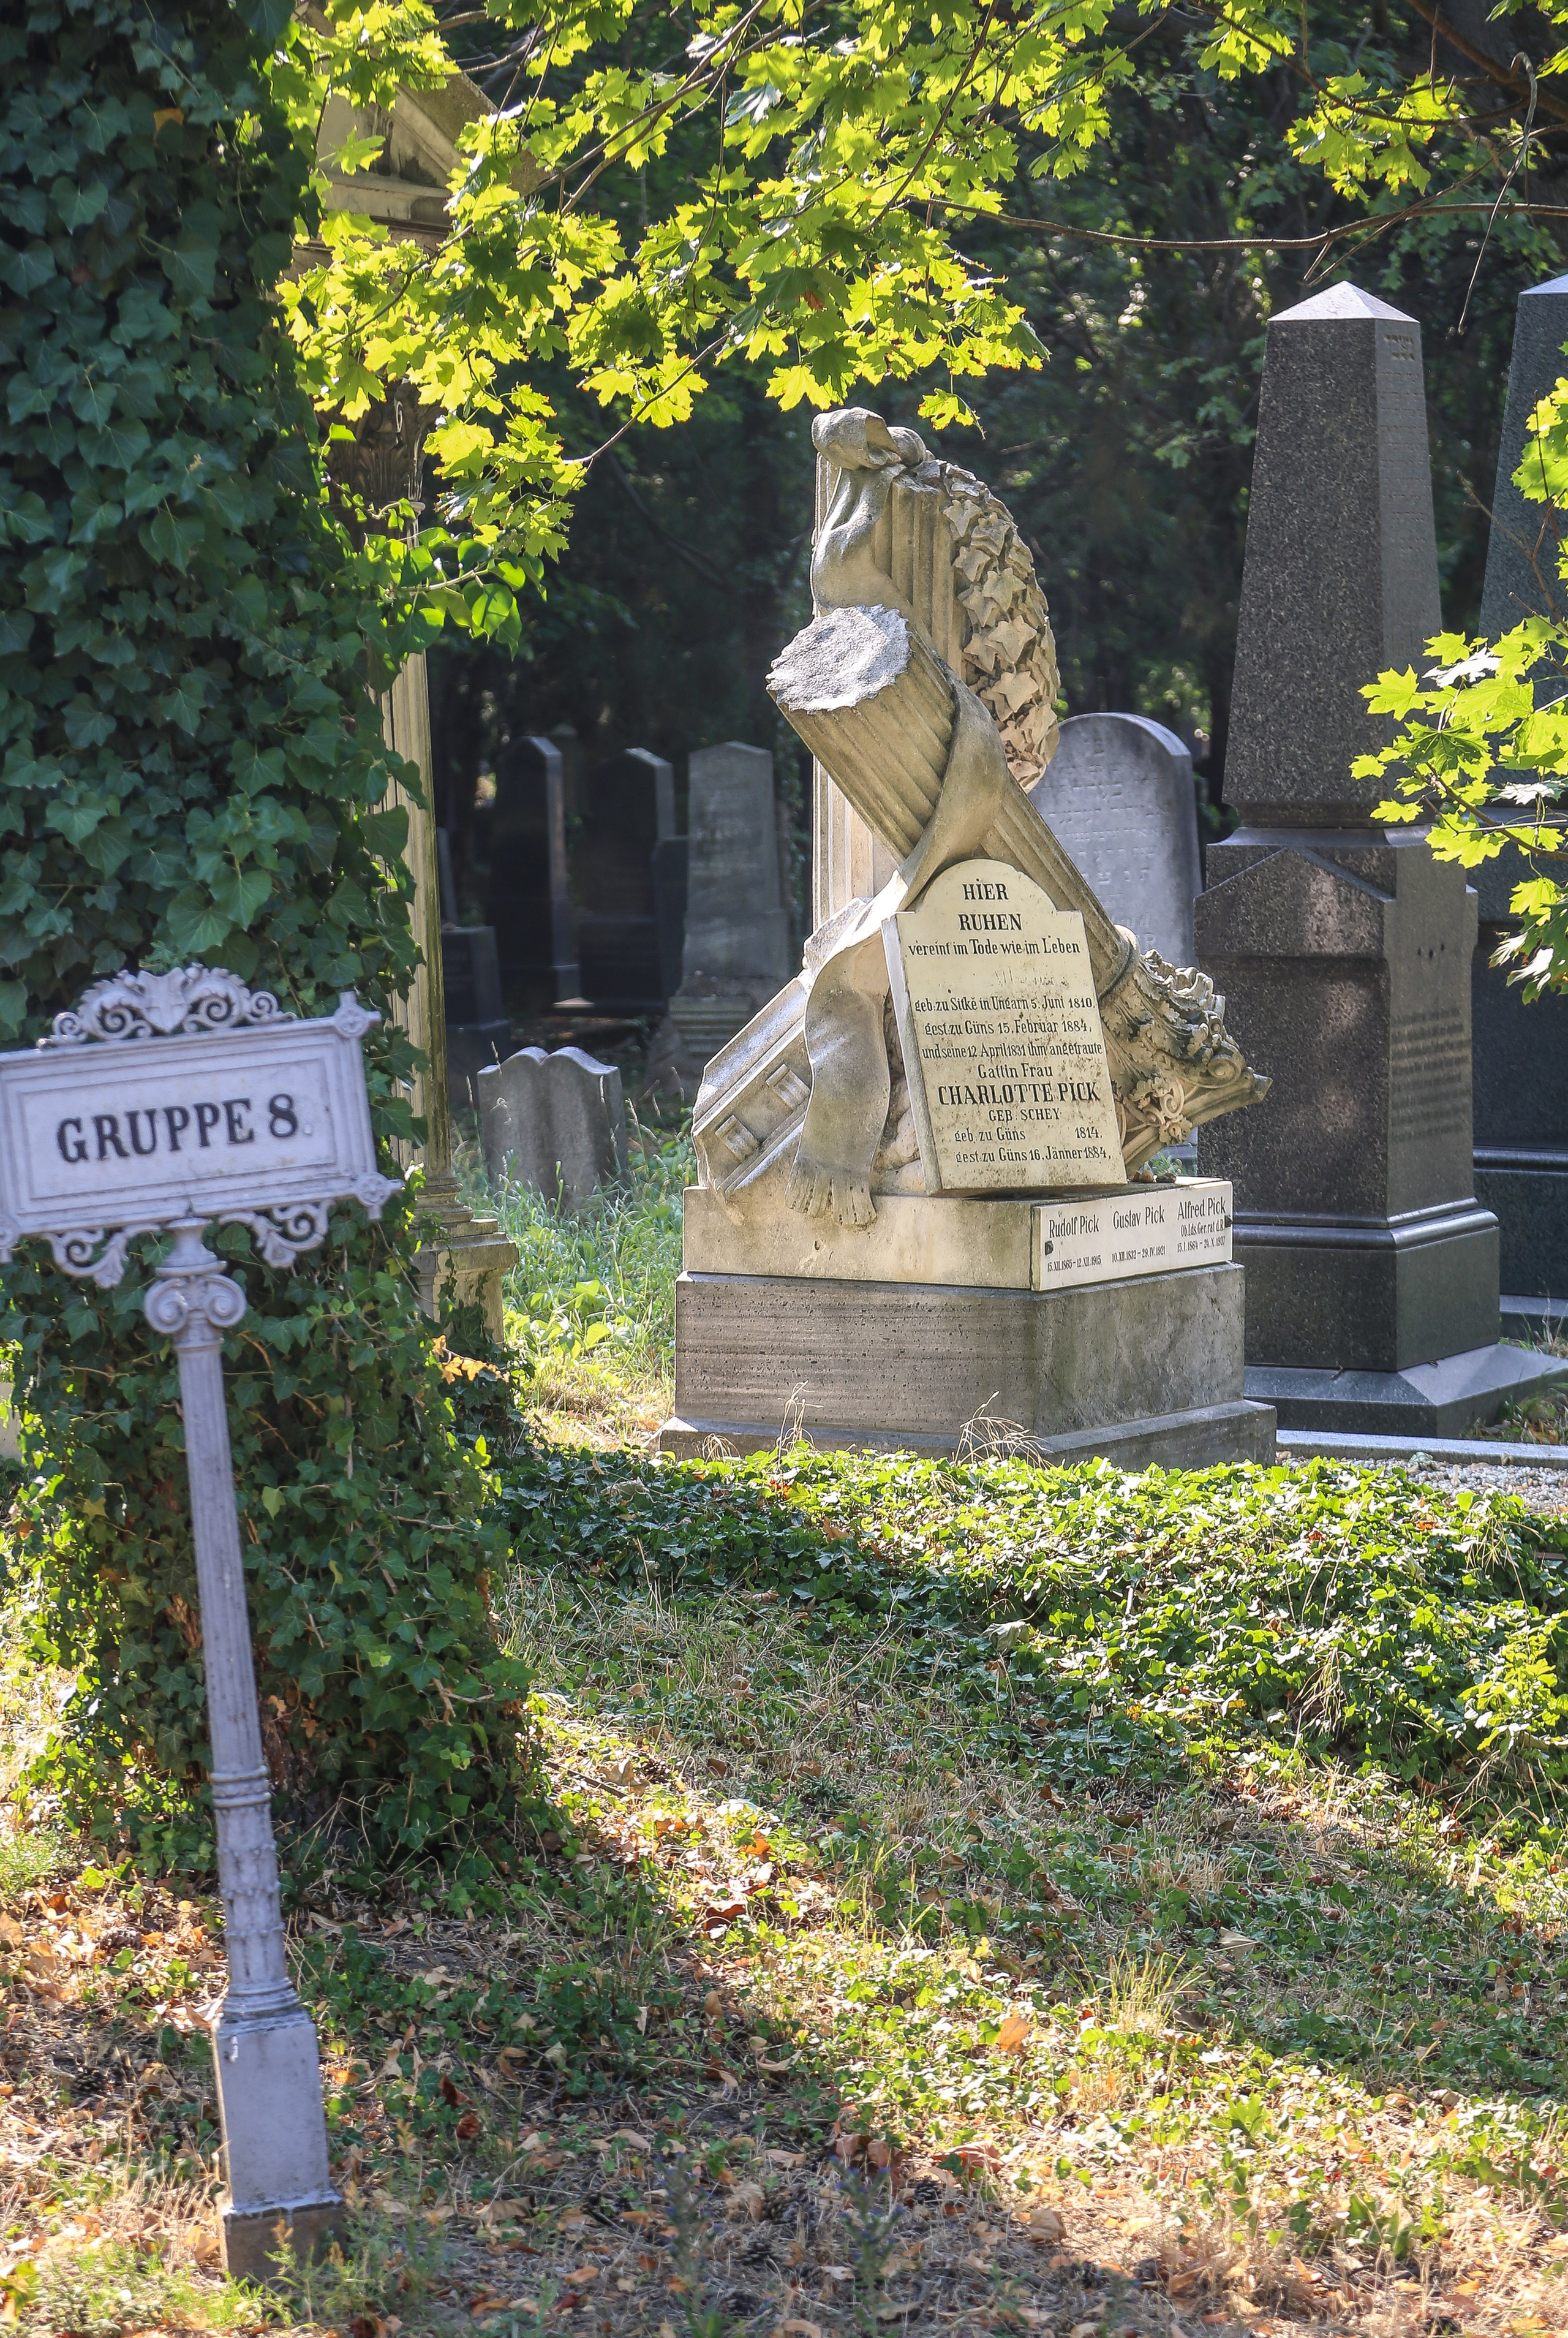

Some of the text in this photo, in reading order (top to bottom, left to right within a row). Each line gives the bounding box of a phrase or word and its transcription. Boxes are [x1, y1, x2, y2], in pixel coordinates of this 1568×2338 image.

[962, 883, 1009, 901] HIER
[958, 913, 1023, 931] RUHEN
[908, 937, 1080, 956] vereint im Tode wie im Leben
[979, 997, 990, 1010] in
[990, 996, 1029, 1010] Ungarn
[1042, 995, 1065, 1010] Juni
[965, 1020, 995, 1035] Güns
[997, 1022, 1014, 1034] 15.
[1014, 1018, 1058, 1034] Februar
[921, 1043, 941, 1059] und
[941, 1046, 967, 1059] seine
[981, 1042, 1008, 1059] April
[1006, 1044, 1026, 1057] 1831
[1027, 1042, 1047, 1056] ihm
[1049, 1042, 1103, 1056] angetraute
[978, 1062, 1054, 1078] Gattin Frau
[938, 1081, 1101, 1105] CHARLOTTE PICK
[1020, 1107, 1060, 1121] SCHEY
[56, 1093, 299, 1163] GRUPPE 8
[979, 1130, 993, 1141] zu
[997, 1127, 1026, 1141] Güns
[982, 1152, 995, 1162] zu
[998, 1147, 1028, 1162] Güns
[1045, 1145, 1082, 1160] Jänner
[1177, 1196, 1226, 1220] Alfred Pick
[1049, 1214, 1099, 1238] Rudolf Pick
[1113, 1205, 1165, 1230] Gustav Pick
